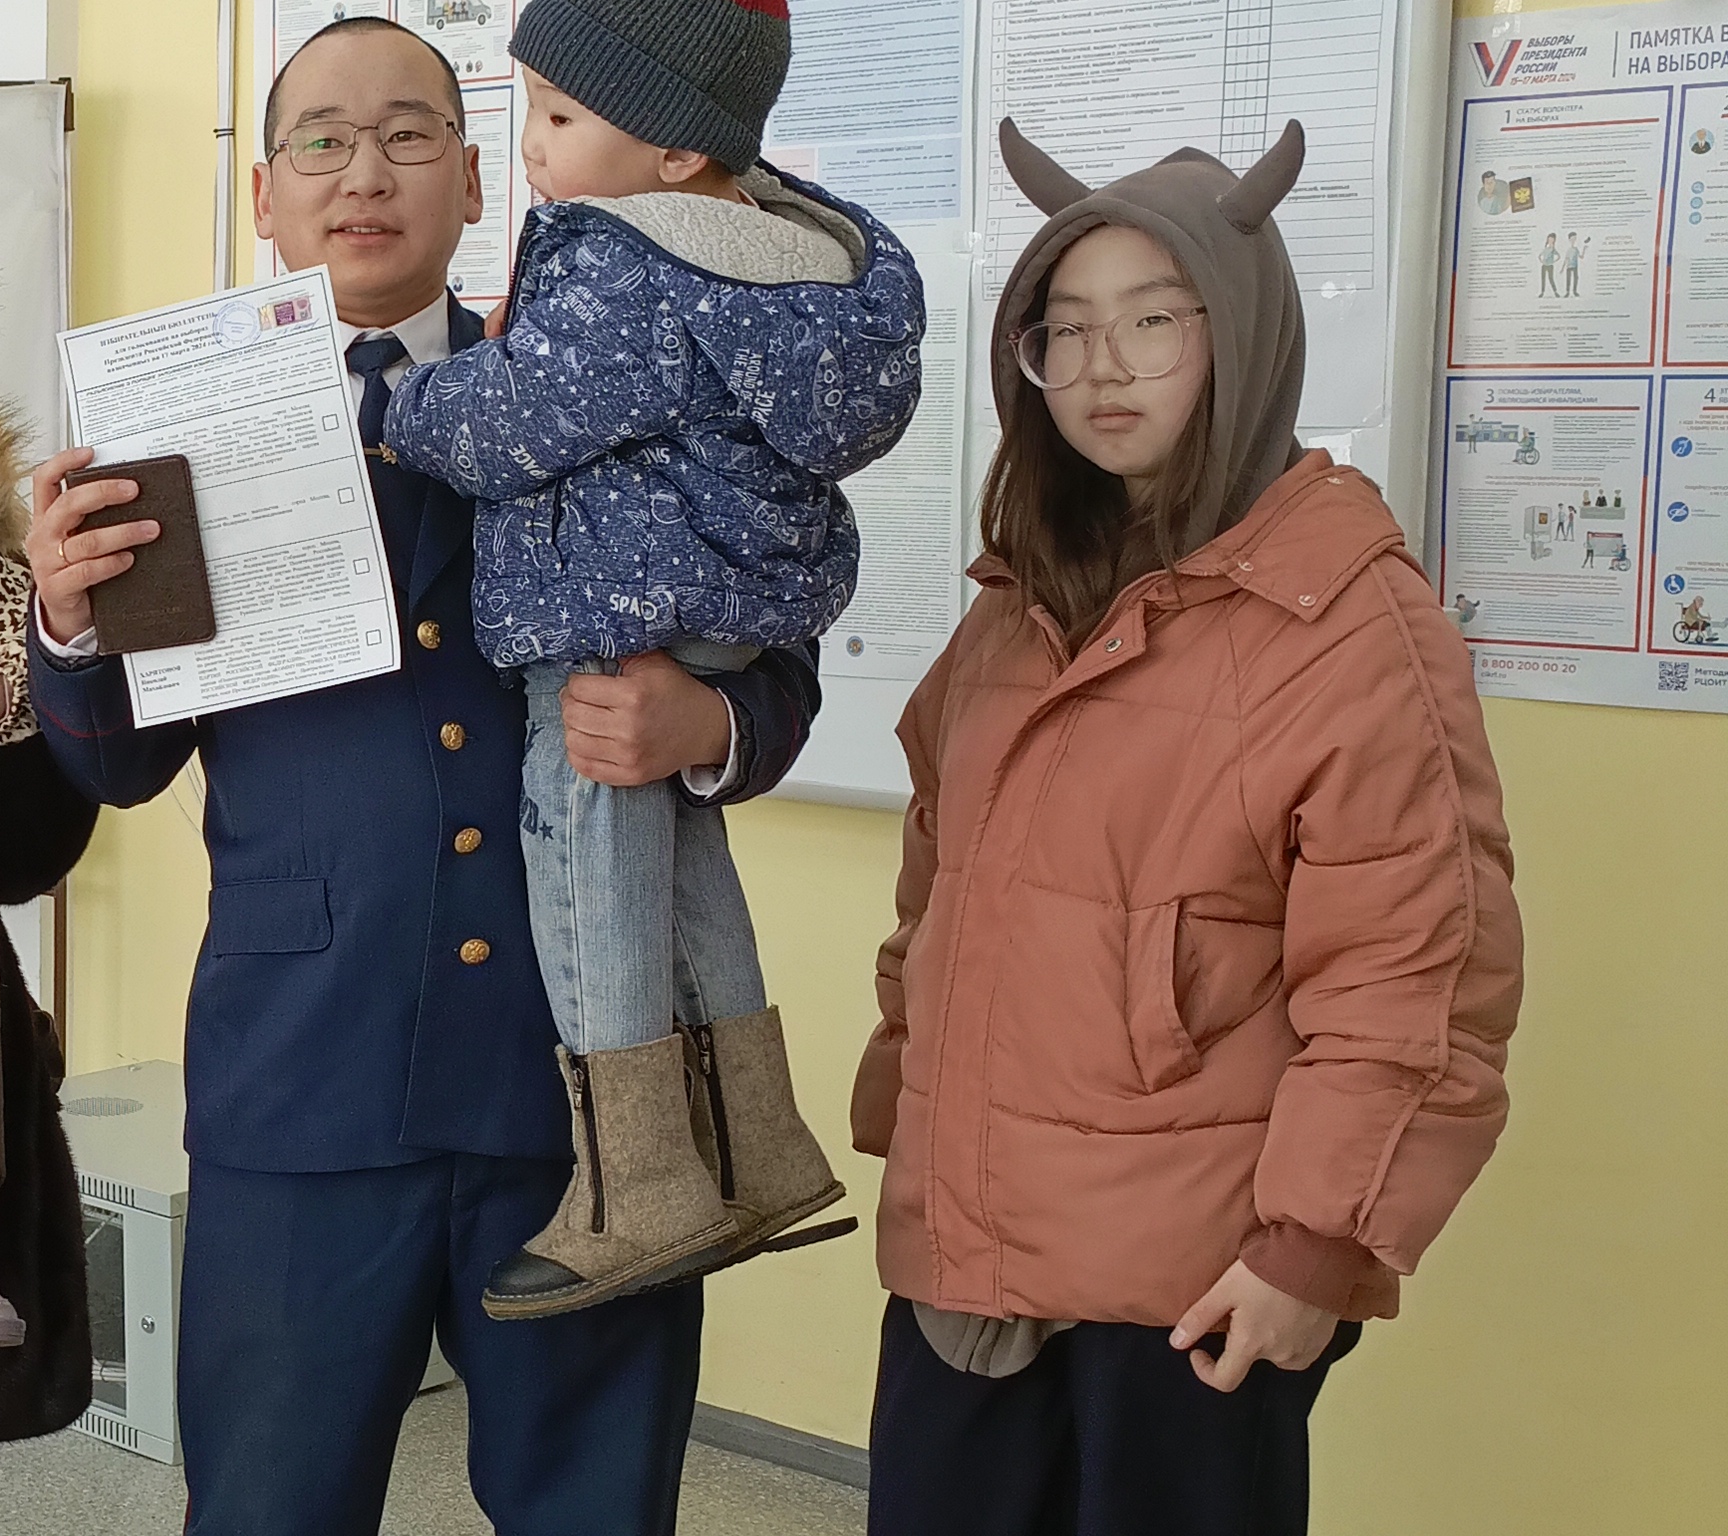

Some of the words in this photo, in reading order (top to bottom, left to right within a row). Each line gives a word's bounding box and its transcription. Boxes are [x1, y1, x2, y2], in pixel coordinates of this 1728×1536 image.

[1527, 35, 1575, 48] ВЫБОРЫ
[1630, 25, 1714, 49] ПАМЯТКА
[1521, 47, 1587, 61] ПРЕЗИДЕНТА
[1515, 62, 1558, 74] РОССИИ
[1628, 56, 1651, 75] НА
[1505, 110, 1511, 124] 1
[733, 348, 750, 367] THE
[743, 353, 763, 389] AROUND
[1485, 388, 1495, 404] 3
[1704, 388, 1716, 403] 4
[1492, 659, 1514, 669] 800
[1518, 661, 1539, 670] 200
[1543, 663, 1558, 672] 00
[1562, 664, 1576, 673] 20
